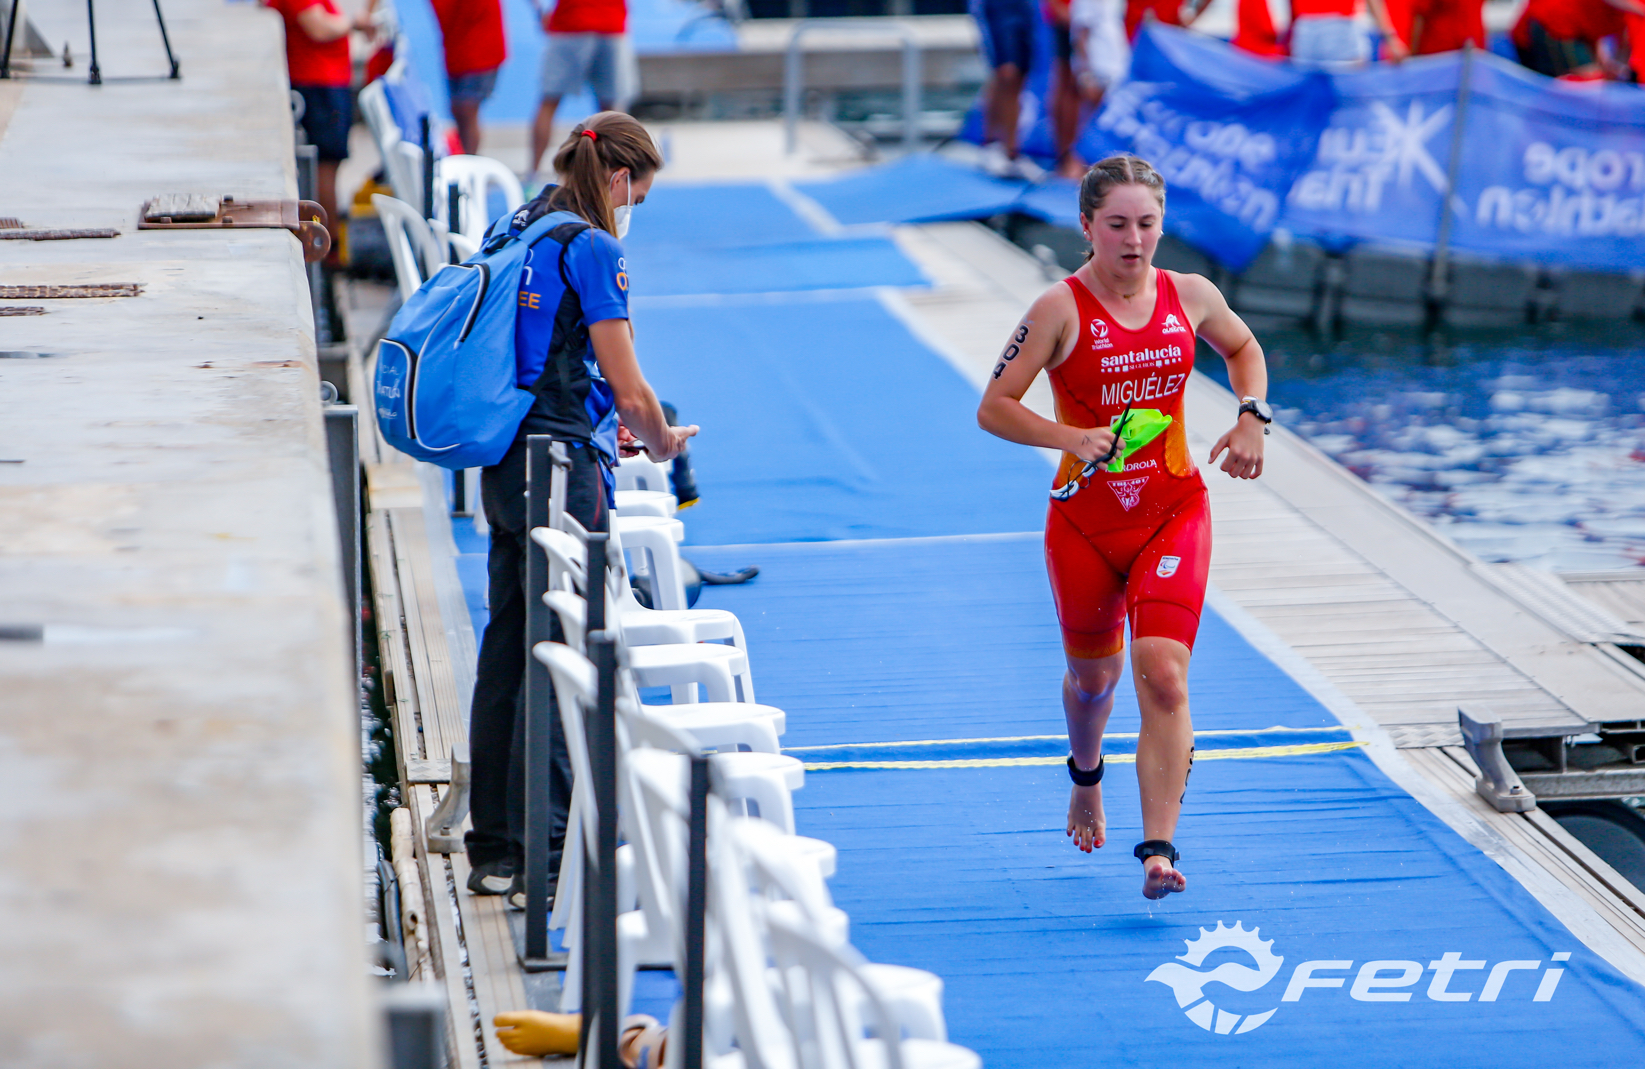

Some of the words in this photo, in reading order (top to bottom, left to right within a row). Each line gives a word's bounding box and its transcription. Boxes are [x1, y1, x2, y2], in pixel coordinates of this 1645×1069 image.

[993, 325, 1029, 380] 304
[1101, 344, 1181, 367] santalucia
[1101, 372, 1185, 405] MIGUÉLEZ
